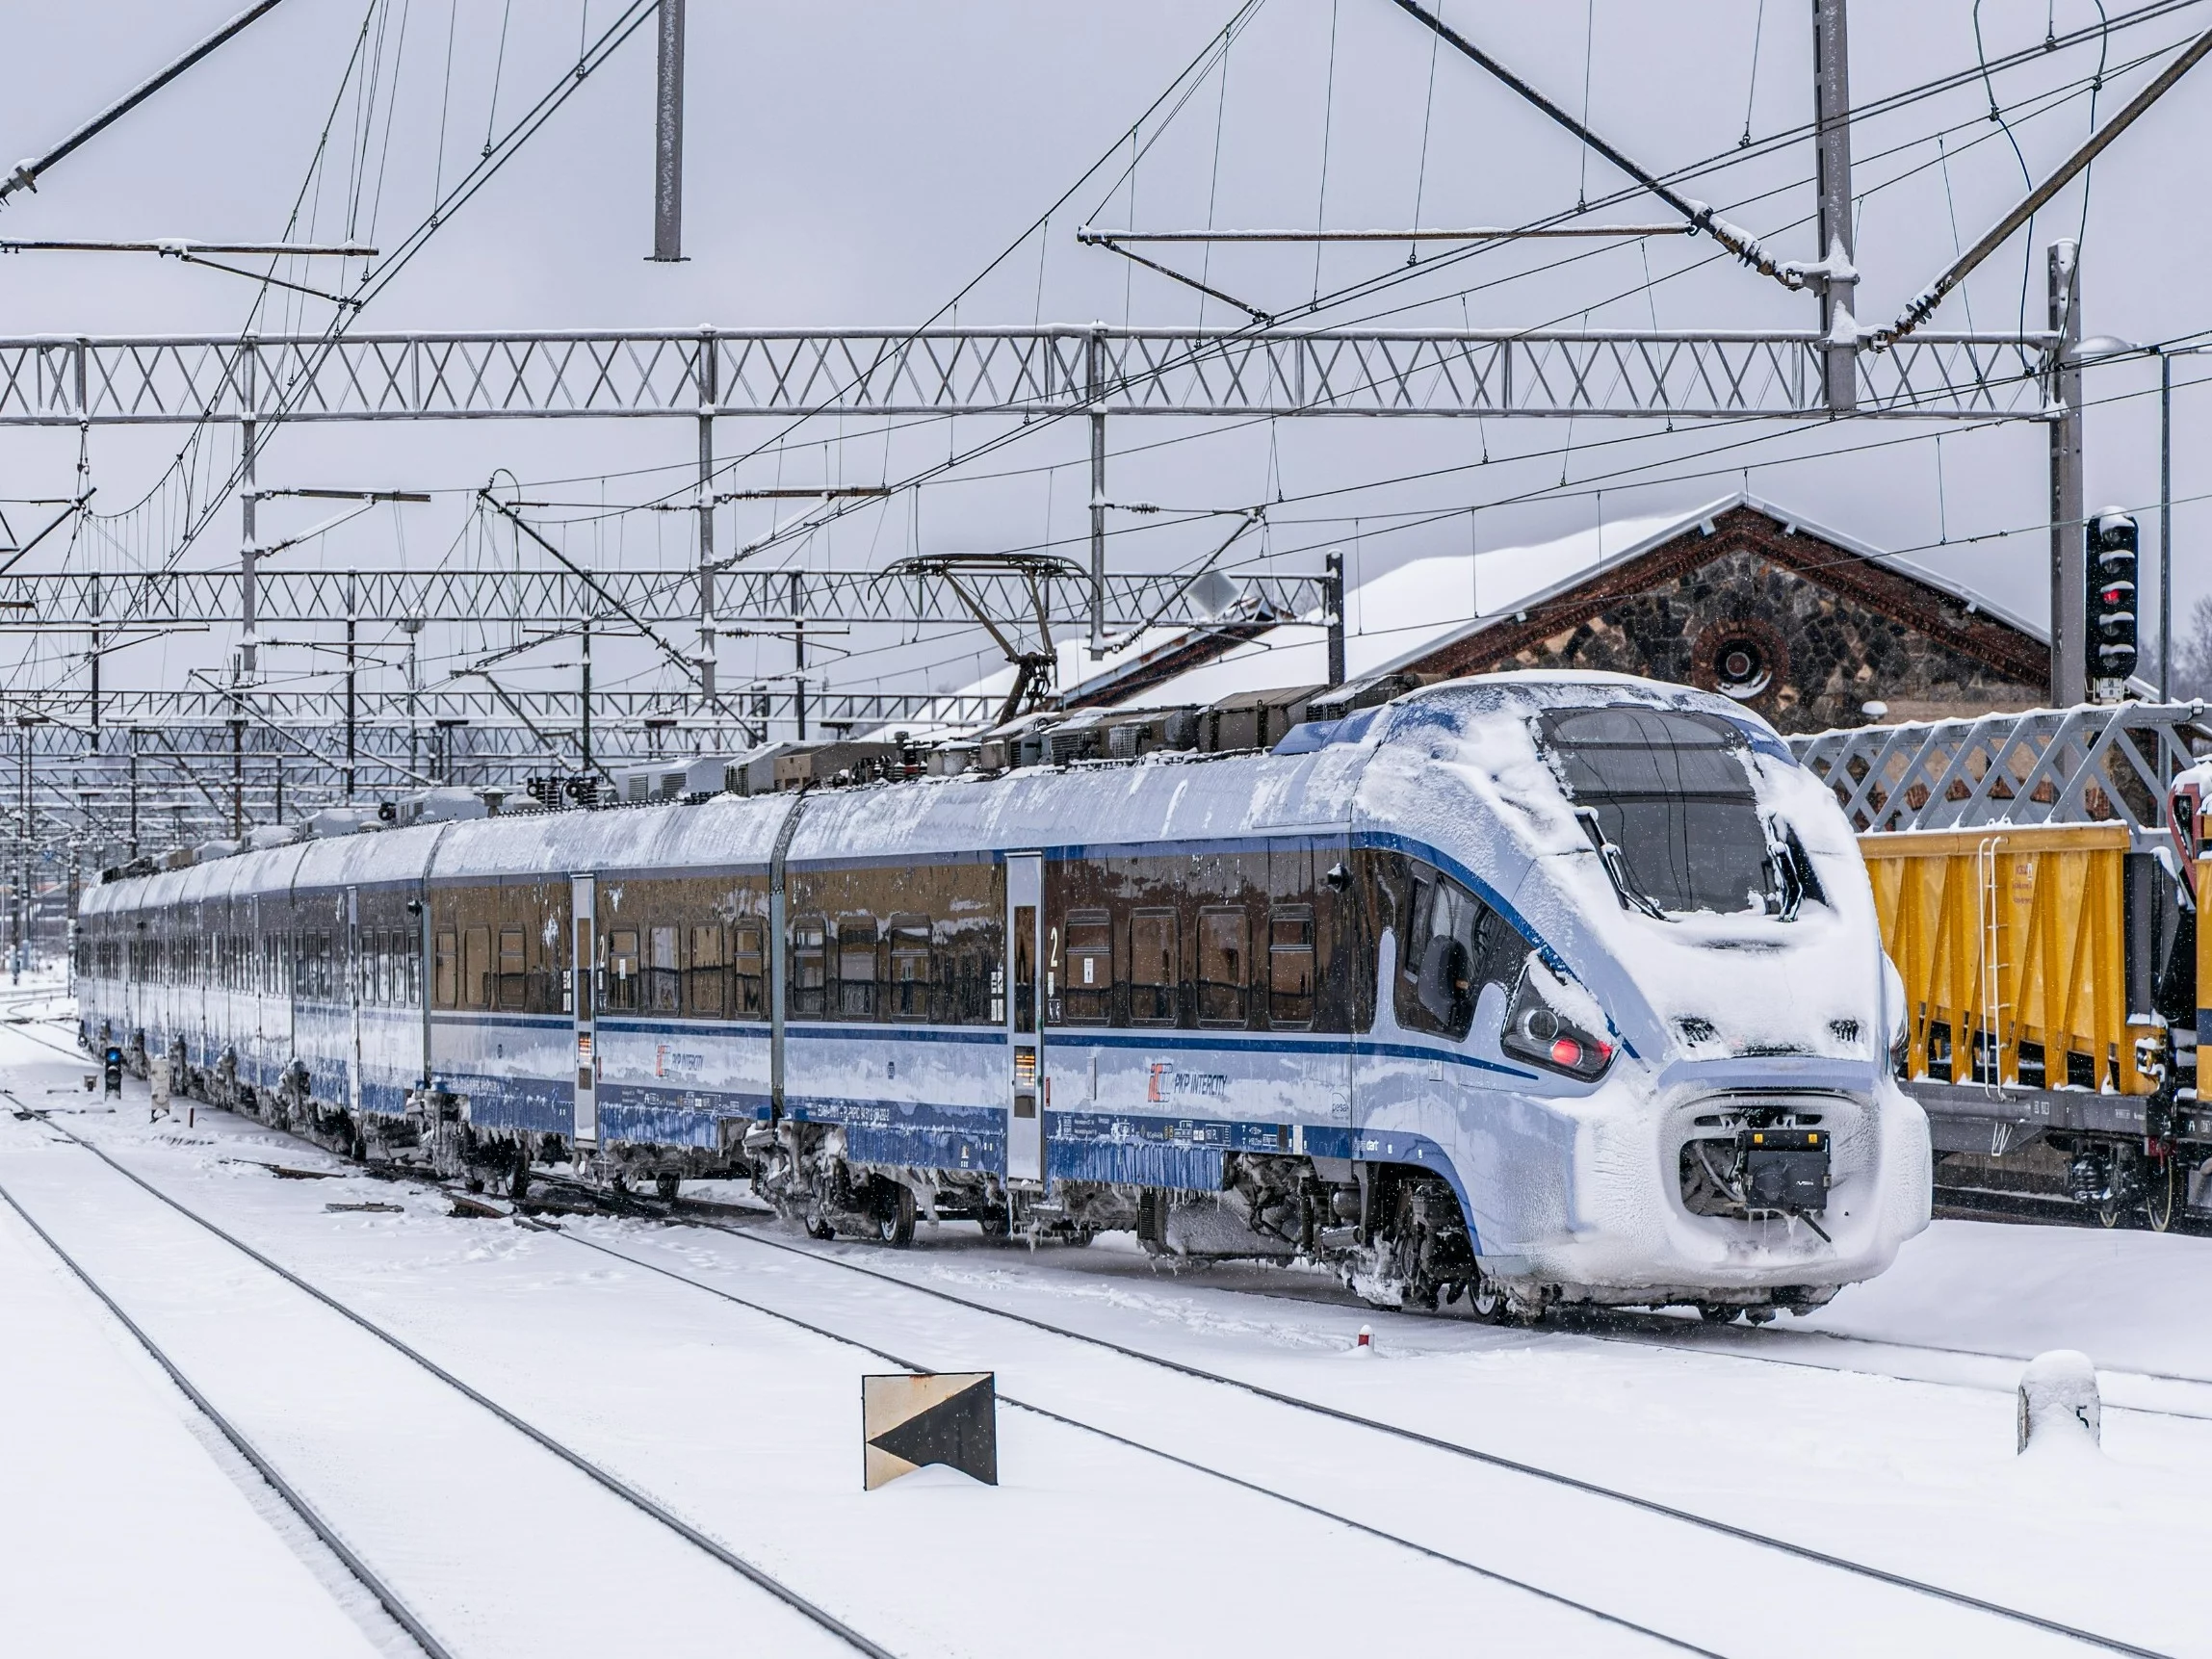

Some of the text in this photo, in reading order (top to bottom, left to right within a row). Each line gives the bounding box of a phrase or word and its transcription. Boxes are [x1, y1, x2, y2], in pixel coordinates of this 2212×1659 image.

[1051, 927, 1057, 967] 2
[1174, 1073, 1228, 1096] PKP INTERCITY
[1332, 1103, 1347, 1114] pesa
[2188, 1120, 2196, 1132] A
[2076, 1405, 2090, 1429] 5
